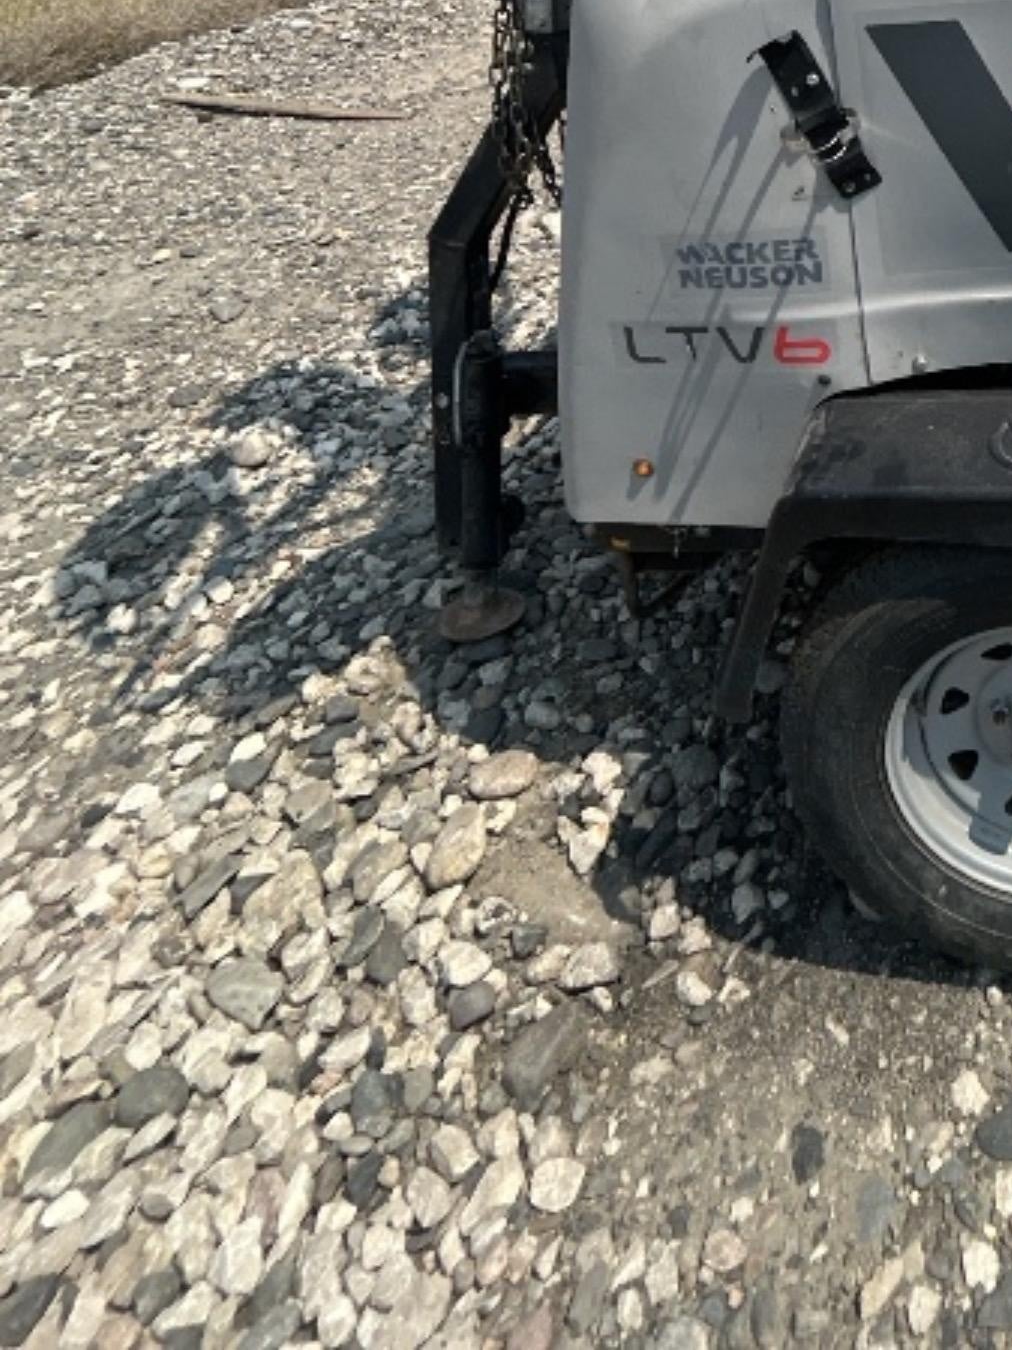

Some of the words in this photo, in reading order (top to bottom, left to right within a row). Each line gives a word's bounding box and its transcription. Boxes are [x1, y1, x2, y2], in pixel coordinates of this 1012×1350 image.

[677, 237, 820, 265] WACKER
[678, 261, 823, 288] NEUSON
[623, 325, 832, 365] LTV6
